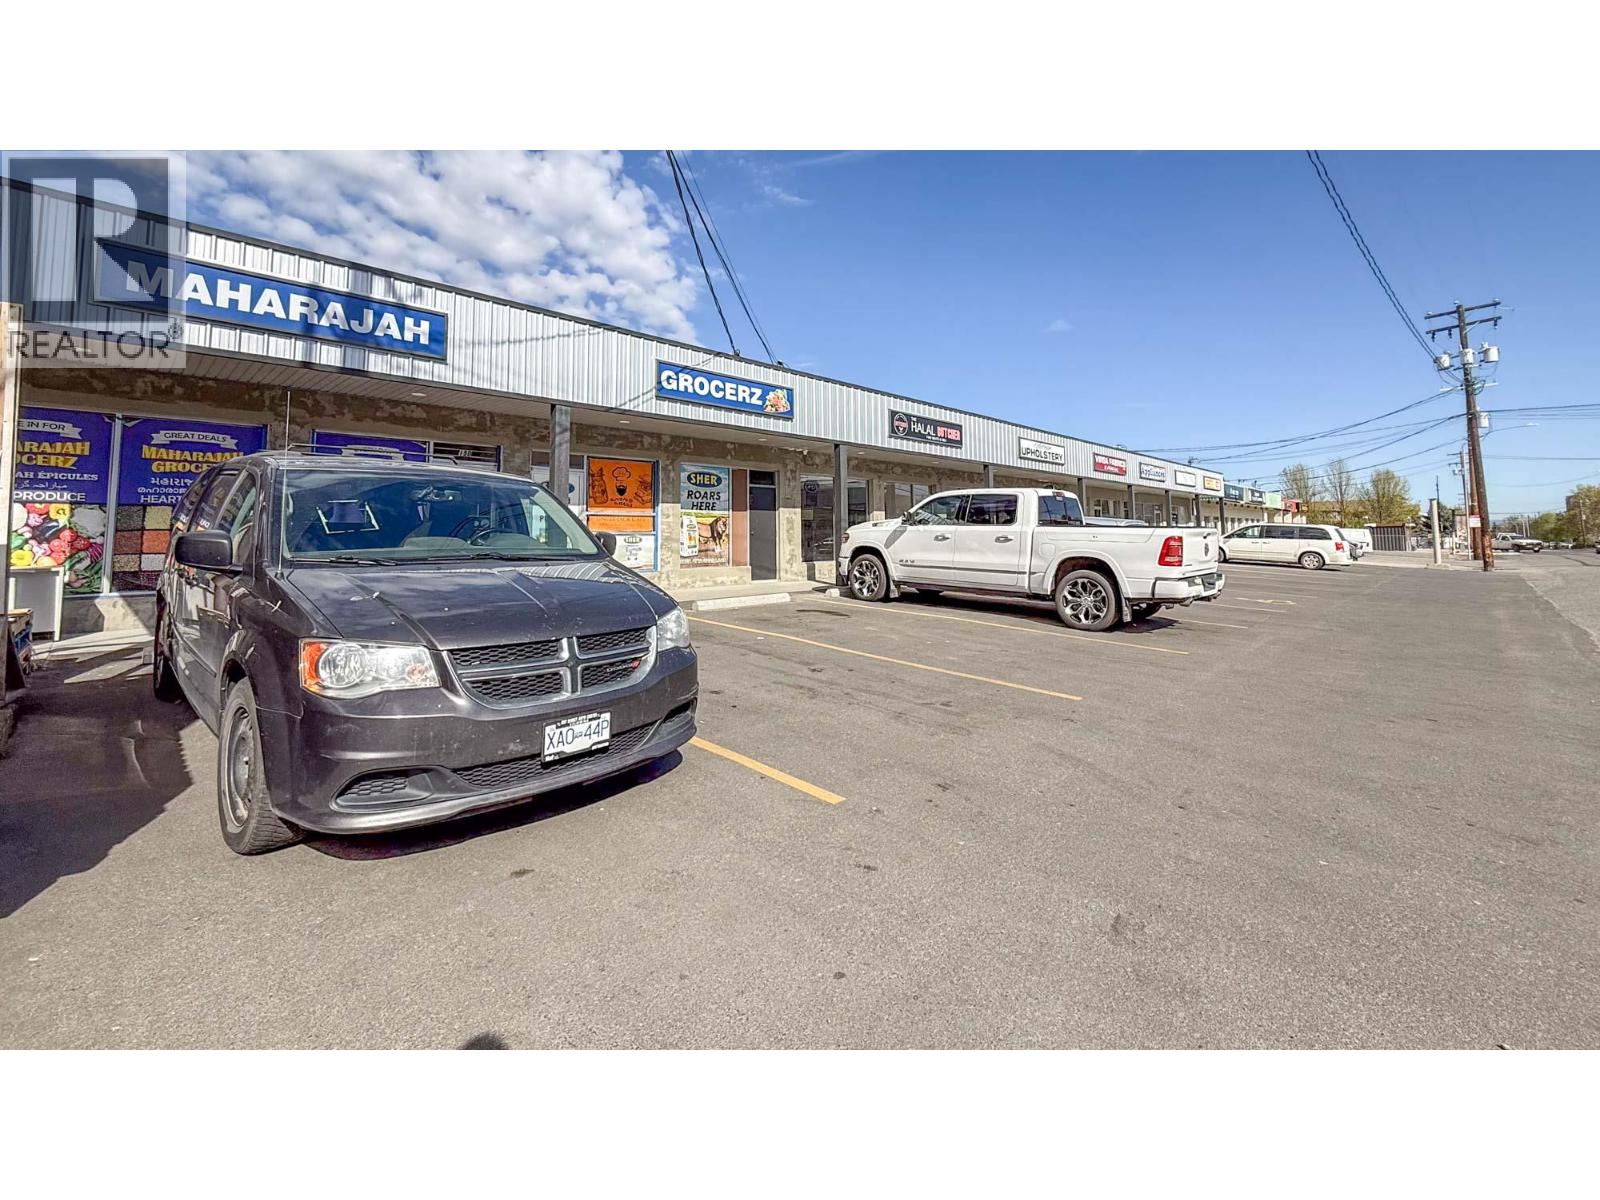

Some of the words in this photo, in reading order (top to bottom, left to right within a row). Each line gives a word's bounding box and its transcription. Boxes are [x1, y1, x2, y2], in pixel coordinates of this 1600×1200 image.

[126, 260, 430, 346] MAHARAJAH
[660, 370, 763, 406] GROCERZ
[42, 423, 66, 431] FOR
[911, 421, 936, 436] HALAL
[197, 433, 227, 442] DEALS
[1021, 447, 1063, 461] UPHOLSTERY
[690, 473, 718, 486] SHER
[13, 491, 86, 502] PRODUCE
[686, 490, 721, 501] ROARS
[691, 501, 717, 511] HERE
